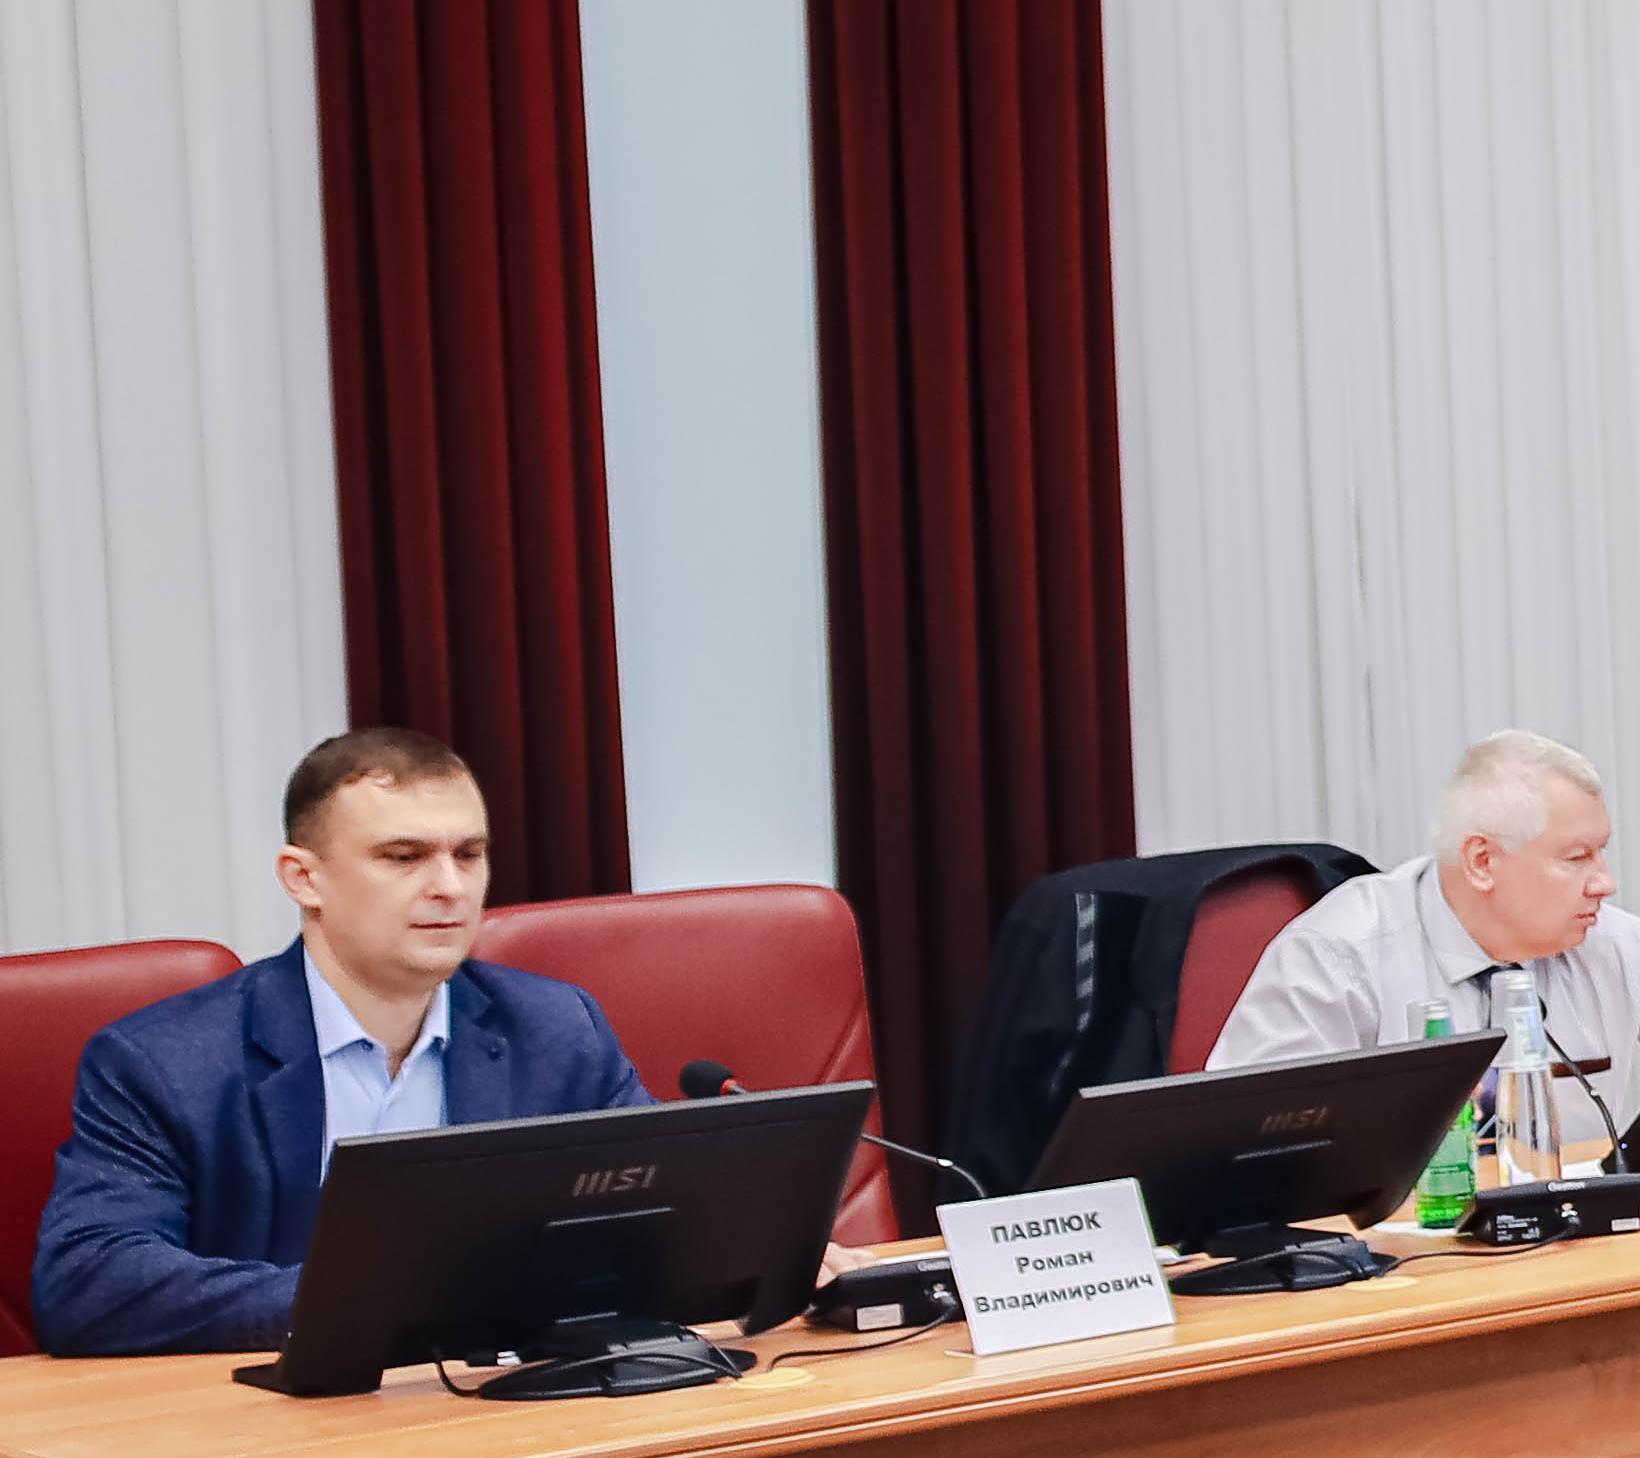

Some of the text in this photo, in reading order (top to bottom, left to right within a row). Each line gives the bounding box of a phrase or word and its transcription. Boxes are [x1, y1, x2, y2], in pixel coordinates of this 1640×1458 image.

[991, 1211, 1102, 1243] ПАВЛЮК
[1016, 1250, 1094, 1274] Роман
[973, 1273, 1153, 1314] Владимирович
